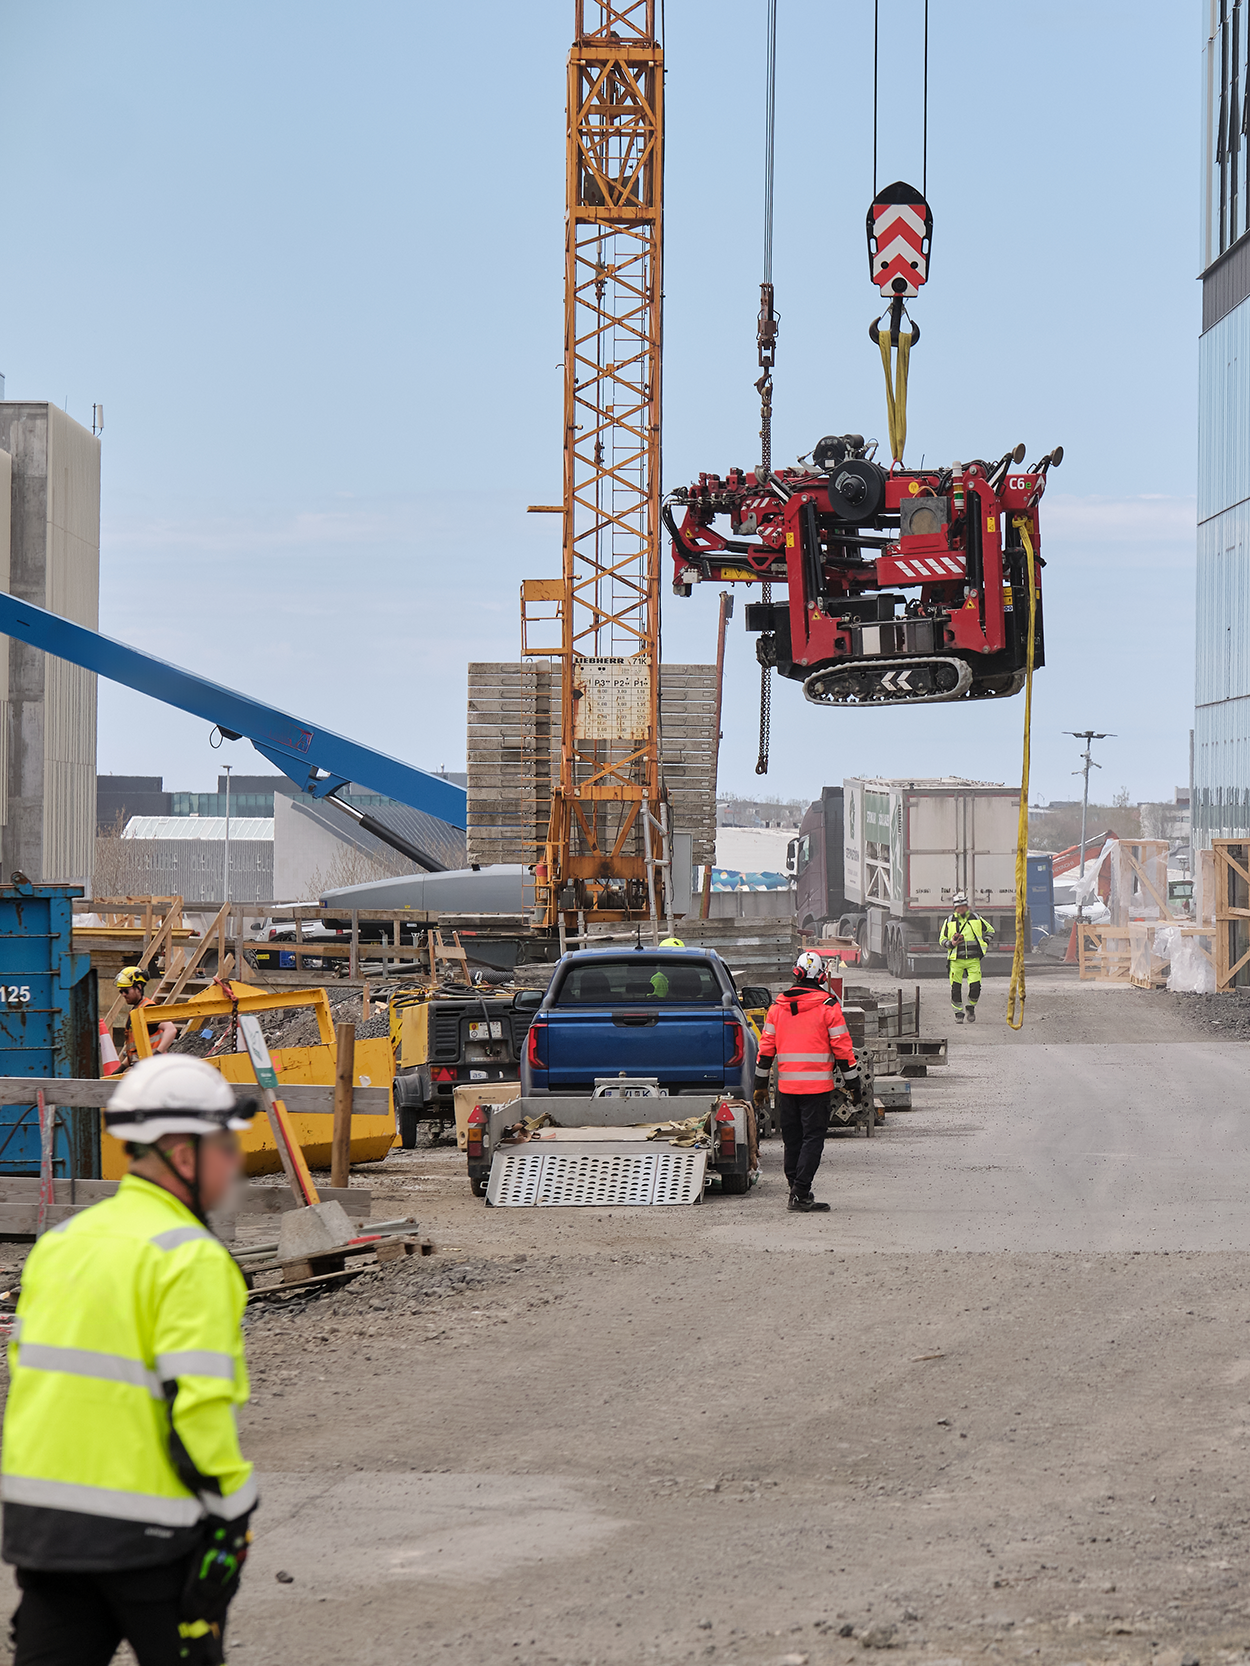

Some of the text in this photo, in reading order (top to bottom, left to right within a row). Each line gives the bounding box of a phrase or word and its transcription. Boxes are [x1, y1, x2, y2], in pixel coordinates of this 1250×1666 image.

[1009, 477, 1032, 490] C6e
[632, 657, 647, 665] 71K
[0, 985, 31, 1002] 125
